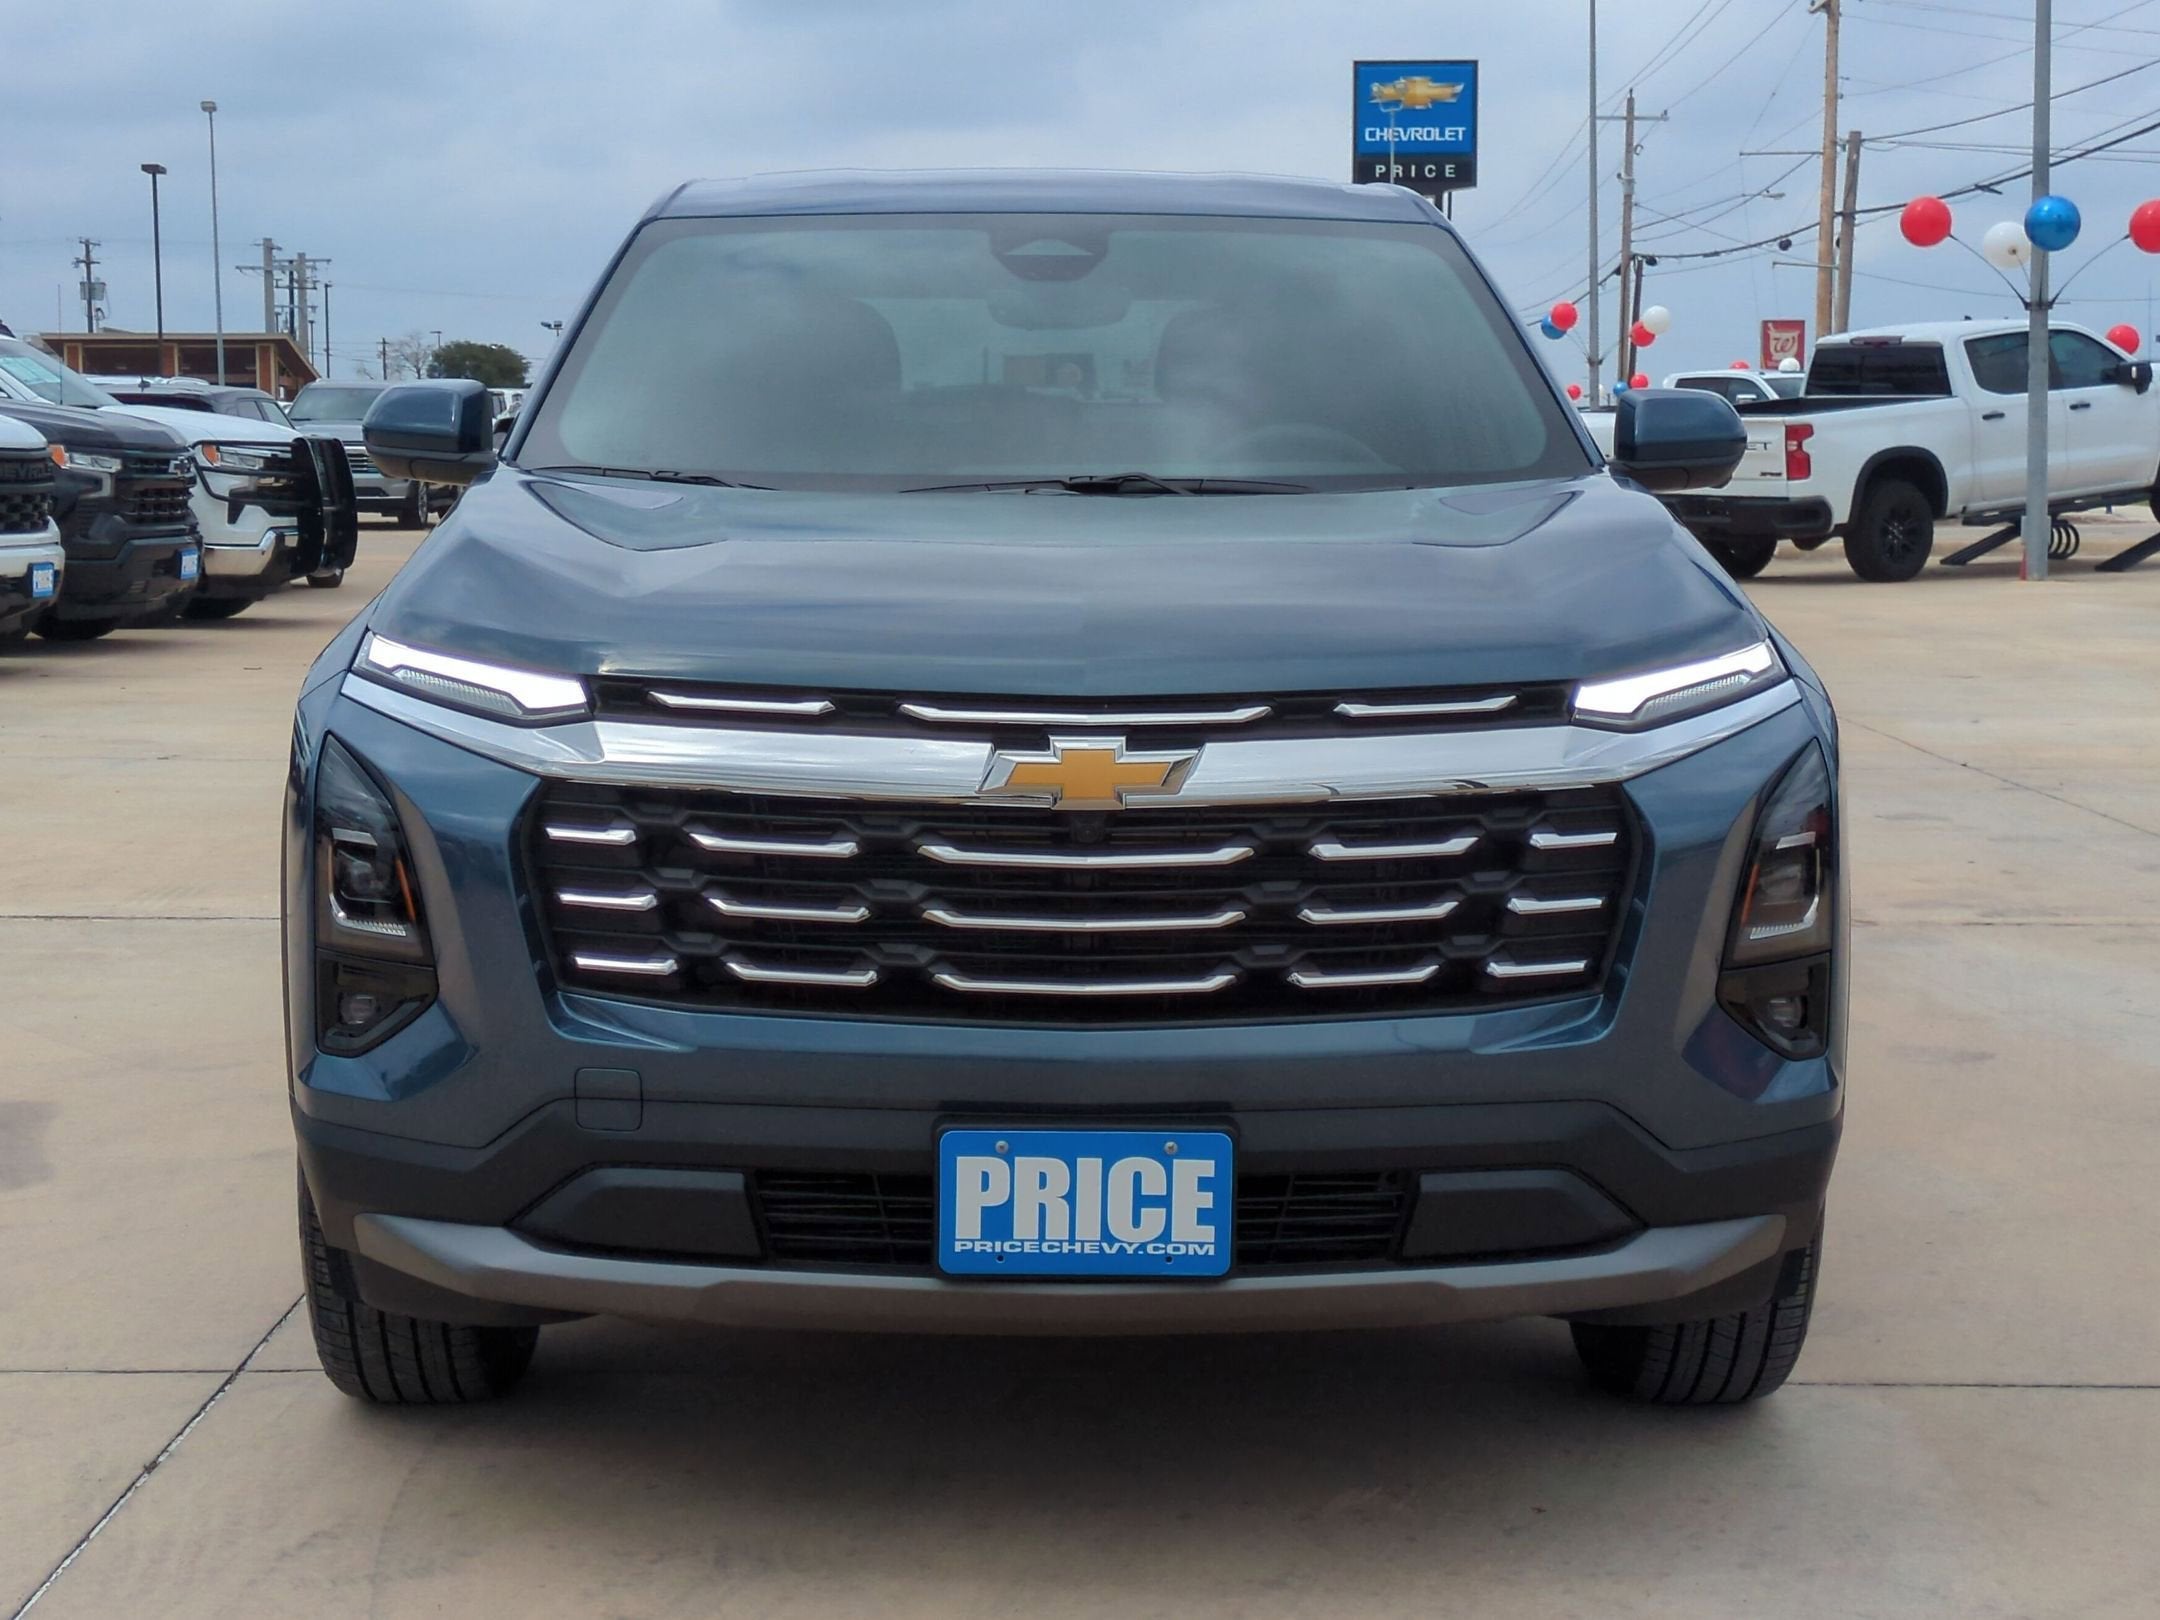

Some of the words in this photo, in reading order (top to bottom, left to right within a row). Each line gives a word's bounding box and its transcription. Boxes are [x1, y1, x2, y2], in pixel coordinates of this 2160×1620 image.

[1365, 127, 1466, 142] CHEVROLET
[1375, 165, 1456, 178] PRICE
[955, 1156, 1215, 1242] PRICE
[954, 1240, 1215, 1256] PRICECHEVY.COM
